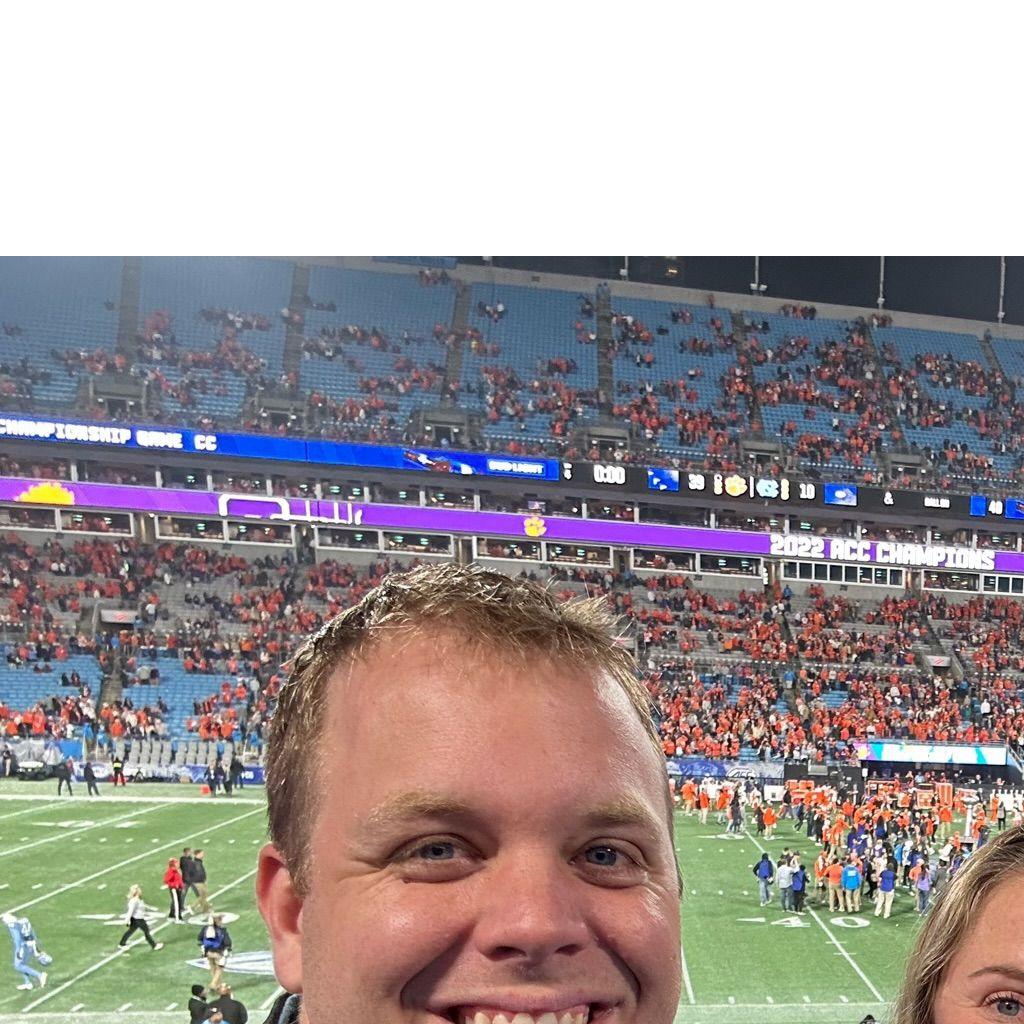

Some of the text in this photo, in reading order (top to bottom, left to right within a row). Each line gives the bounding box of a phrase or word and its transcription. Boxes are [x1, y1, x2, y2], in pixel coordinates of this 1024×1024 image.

[593, 464, 626, 485] 0:00
[770, 534, 996, 571] 2022 ACC CHAMPIONS
